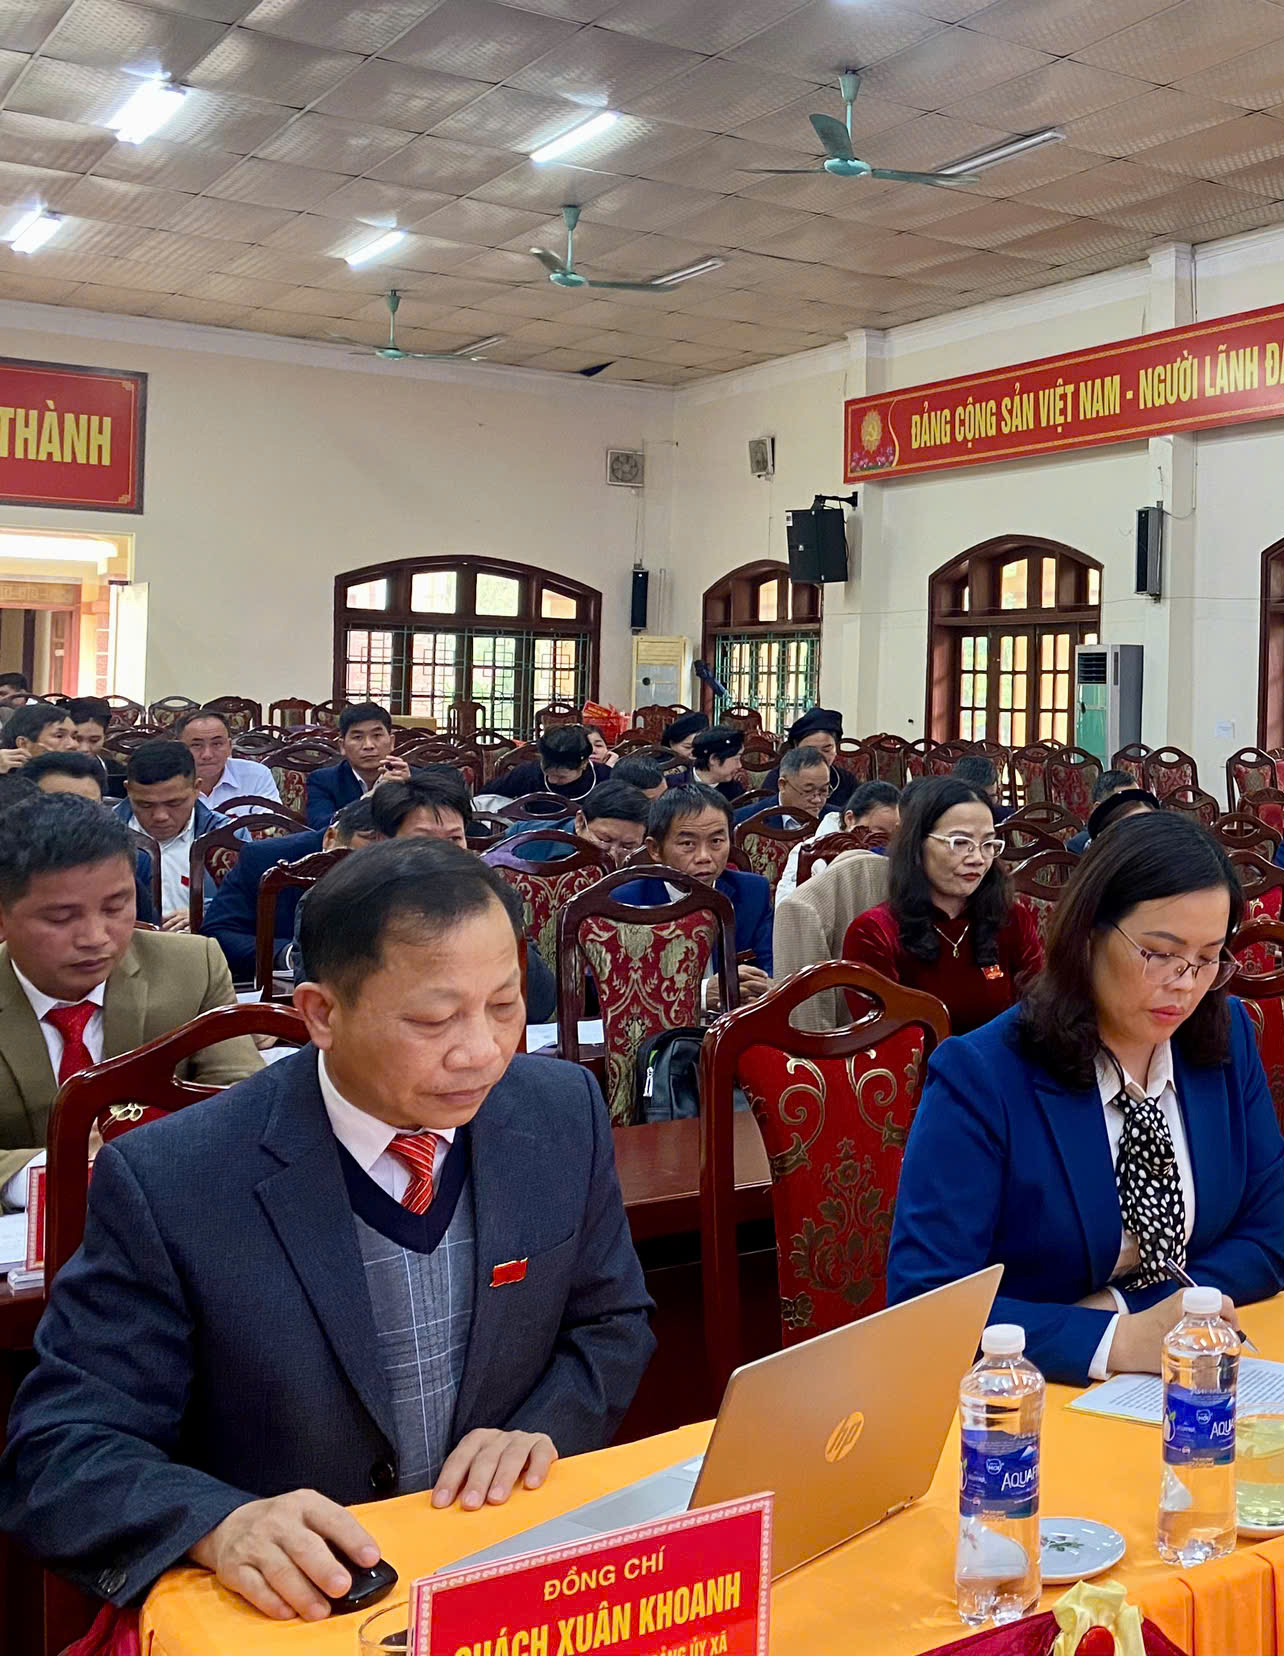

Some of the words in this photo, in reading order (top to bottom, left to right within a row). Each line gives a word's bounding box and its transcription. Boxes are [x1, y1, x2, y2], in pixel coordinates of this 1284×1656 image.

[911, 401, 951, 449] ĐẢNG
[955, 396, 997, 449] CỘNG
[1001, 382, 1035, 434] SẢN
[1039, 378, 1075, 433] VIỆT
[1079, 375, 1121, 420] NAM
[1126, 390, 1134, 400] -
[1139, 350, 1199, 410] NGƯỜI
[1204, 344, 1259, 397] LÃNH
[0, 400, 111, 467] THÀNH
[544, 1565, 616, 1601] ĐỒNG
[624, 1545, 665, 1579] CHÍ
[556, 1600, 631, 1656] XUÂN
[638, 1571, 741, 1636] KHOANH
[710, 1630, 728, 1656] XÃ
